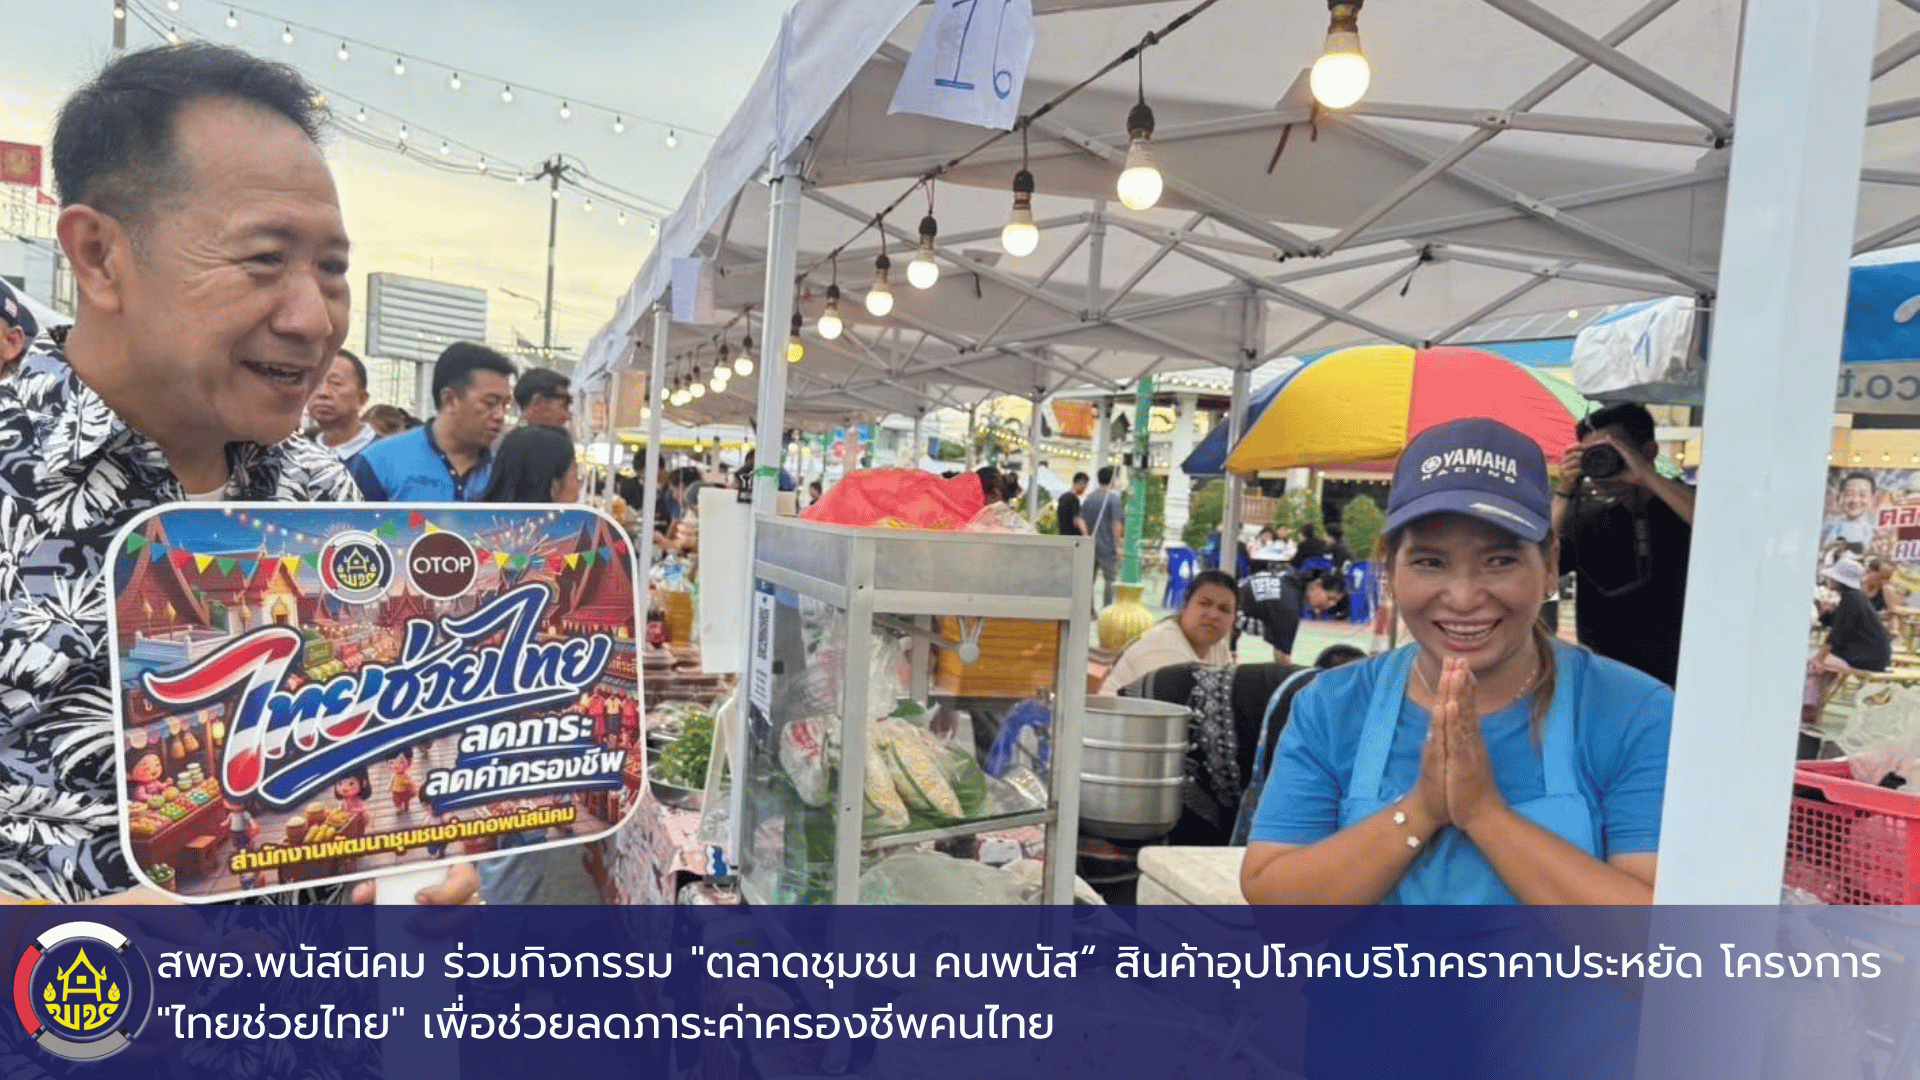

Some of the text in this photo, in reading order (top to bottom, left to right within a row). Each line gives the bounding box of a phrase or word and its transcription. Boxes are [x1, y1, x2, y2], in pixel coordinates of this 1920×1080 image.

[934, 0, 1012, 100] 16
[1443, 448, 1517, 477] YAMAHA
[413, 556, 472, 574] OTOP
[142, 583, 612, 796] ไทยช่วยไทย
[460, 714, 594, 753] ลดภาระ
[425, 747, 625, 796] ลดค่าครองชีพ
[231, 806, 575, 871] สำนักงานพัฒนาชุมชนอำเภอพนัสนิคม
